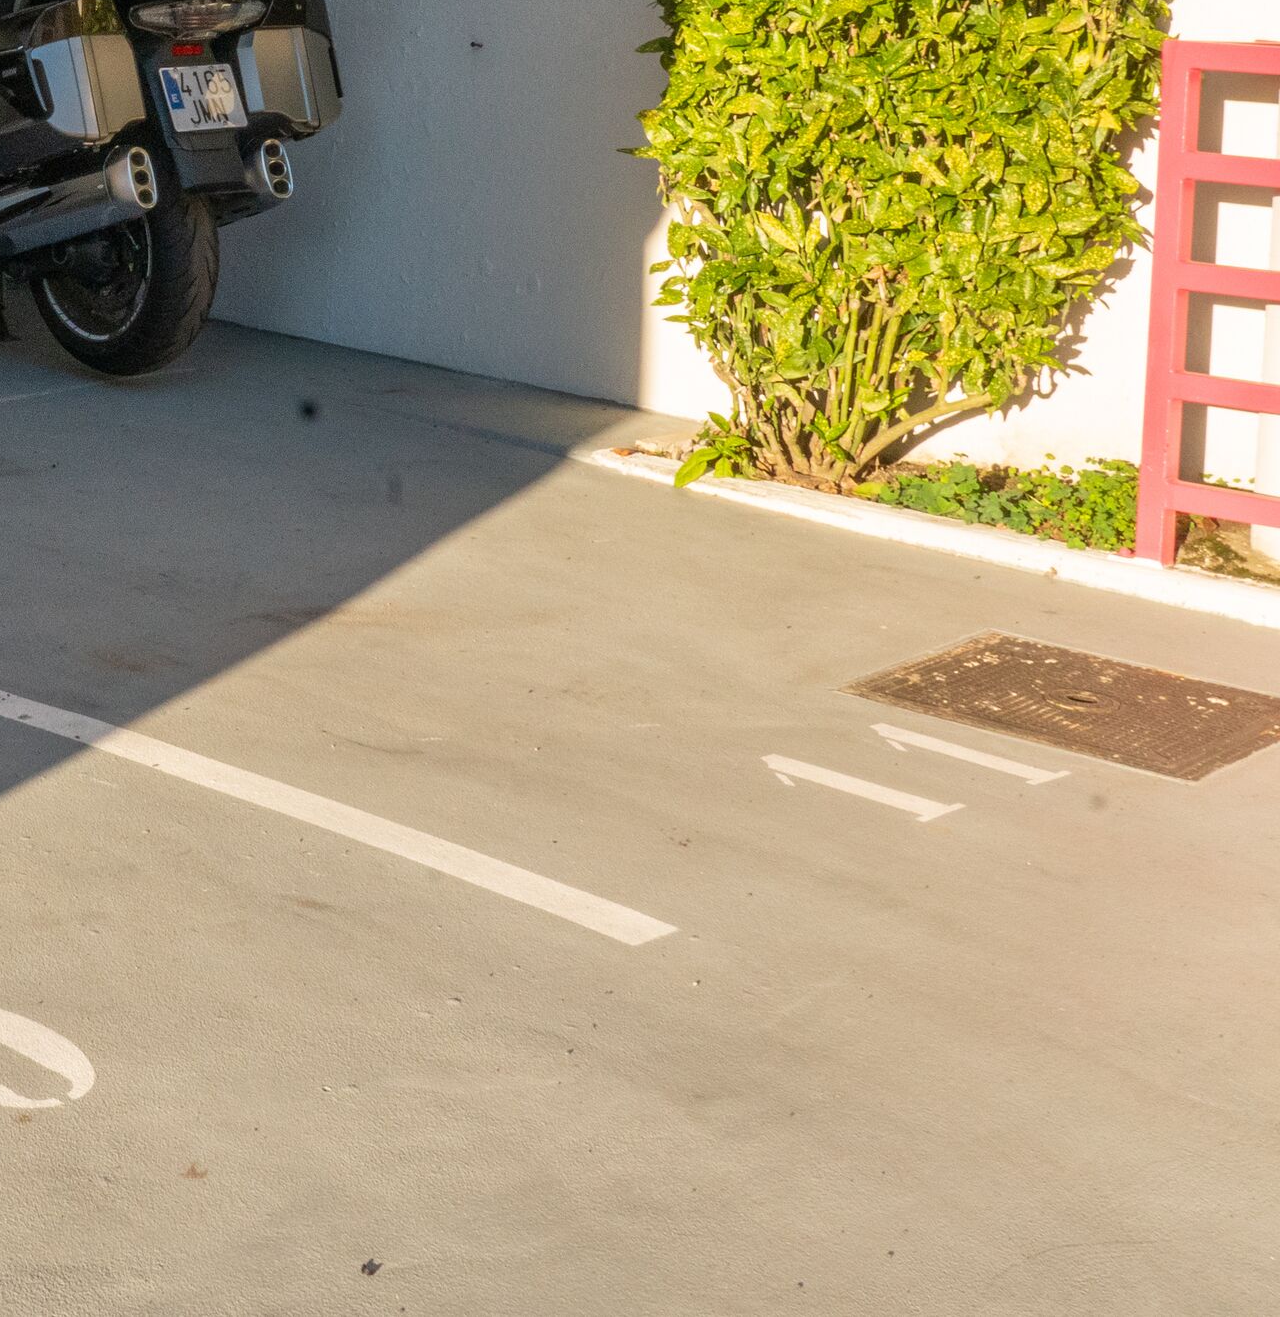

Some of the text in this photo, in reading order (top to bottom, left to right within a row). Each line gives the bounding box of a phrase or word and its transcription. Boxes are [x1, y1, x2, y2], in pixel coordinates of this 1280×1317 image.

[180, 69, 232, 97] 4165
[171, 93, 180, 103] E
[759, 722, 1073, 823] 11
